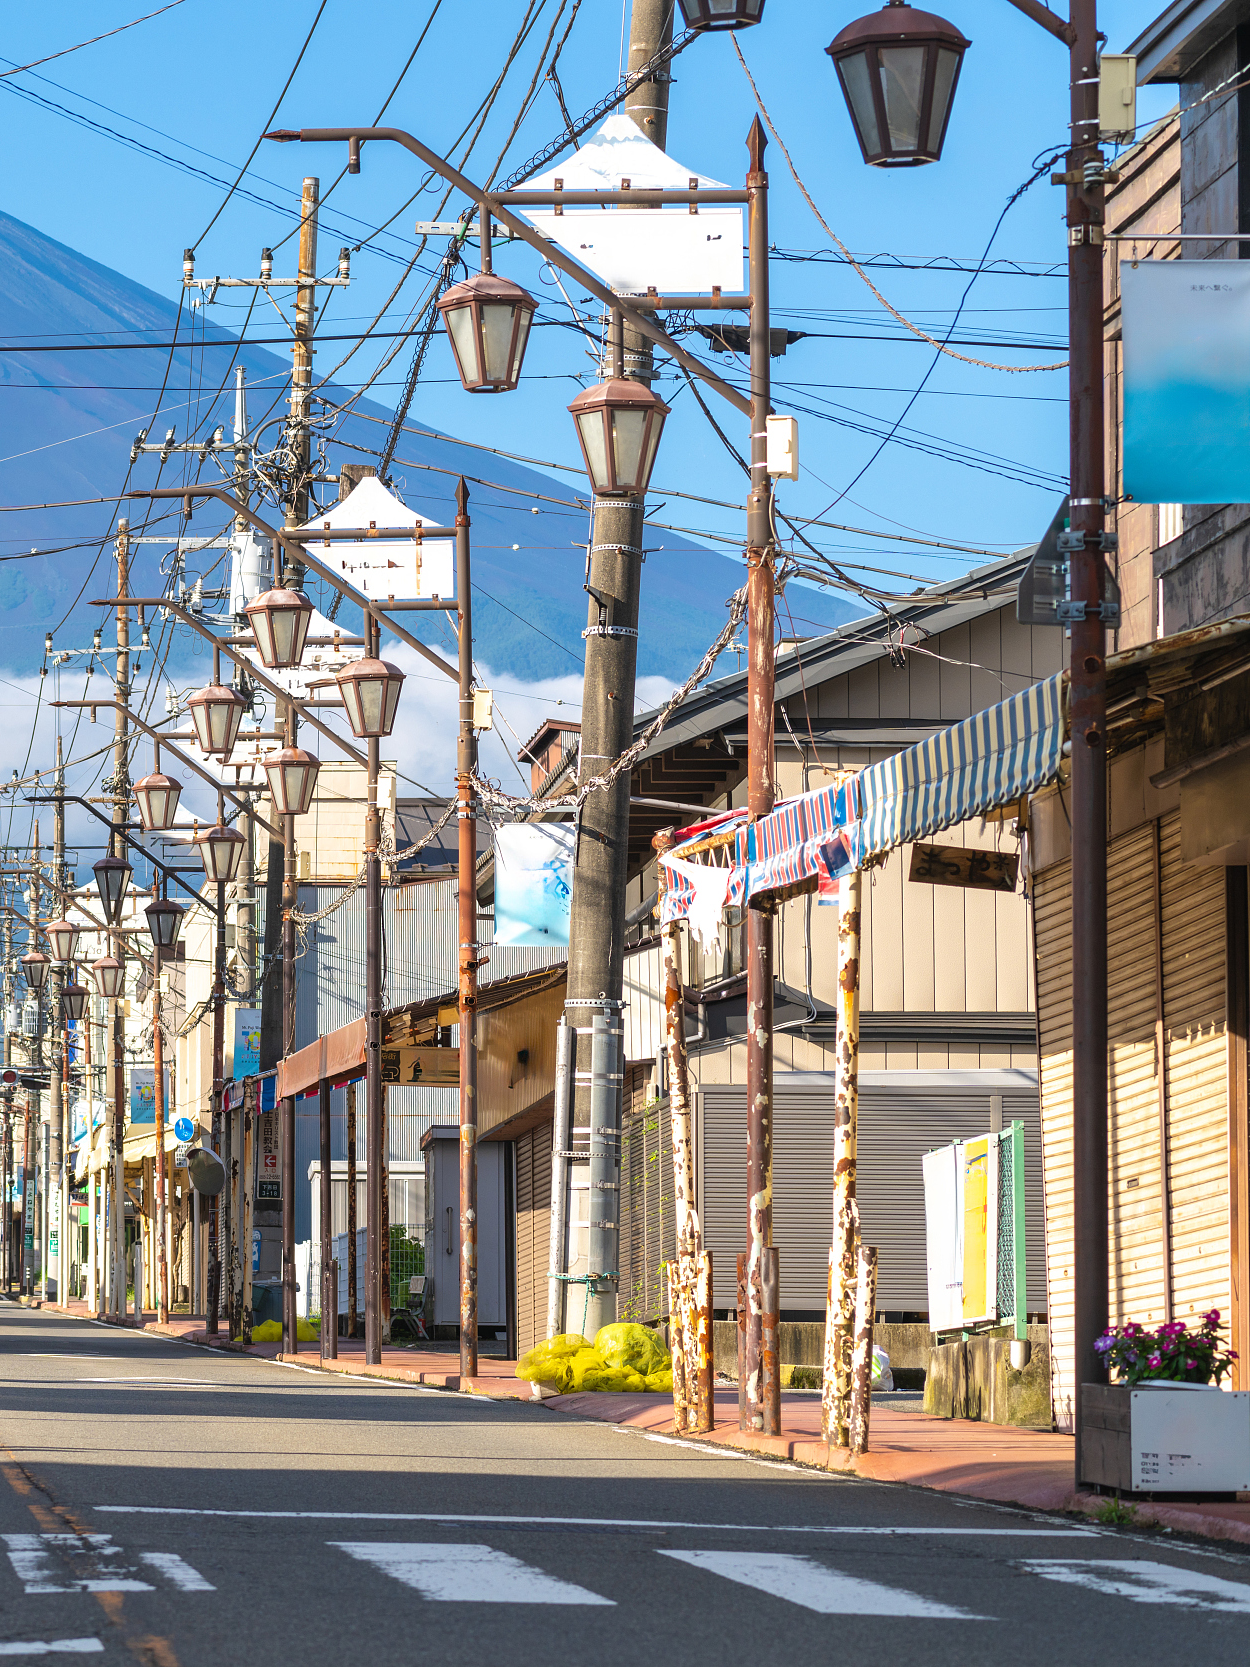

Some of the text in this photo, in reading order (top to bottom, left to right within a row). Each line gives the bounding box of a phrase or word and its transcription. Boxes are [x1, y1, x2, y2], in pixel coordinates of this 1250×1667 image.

[1190, 284, 1233, 292] 未来へ繋ぐ。
